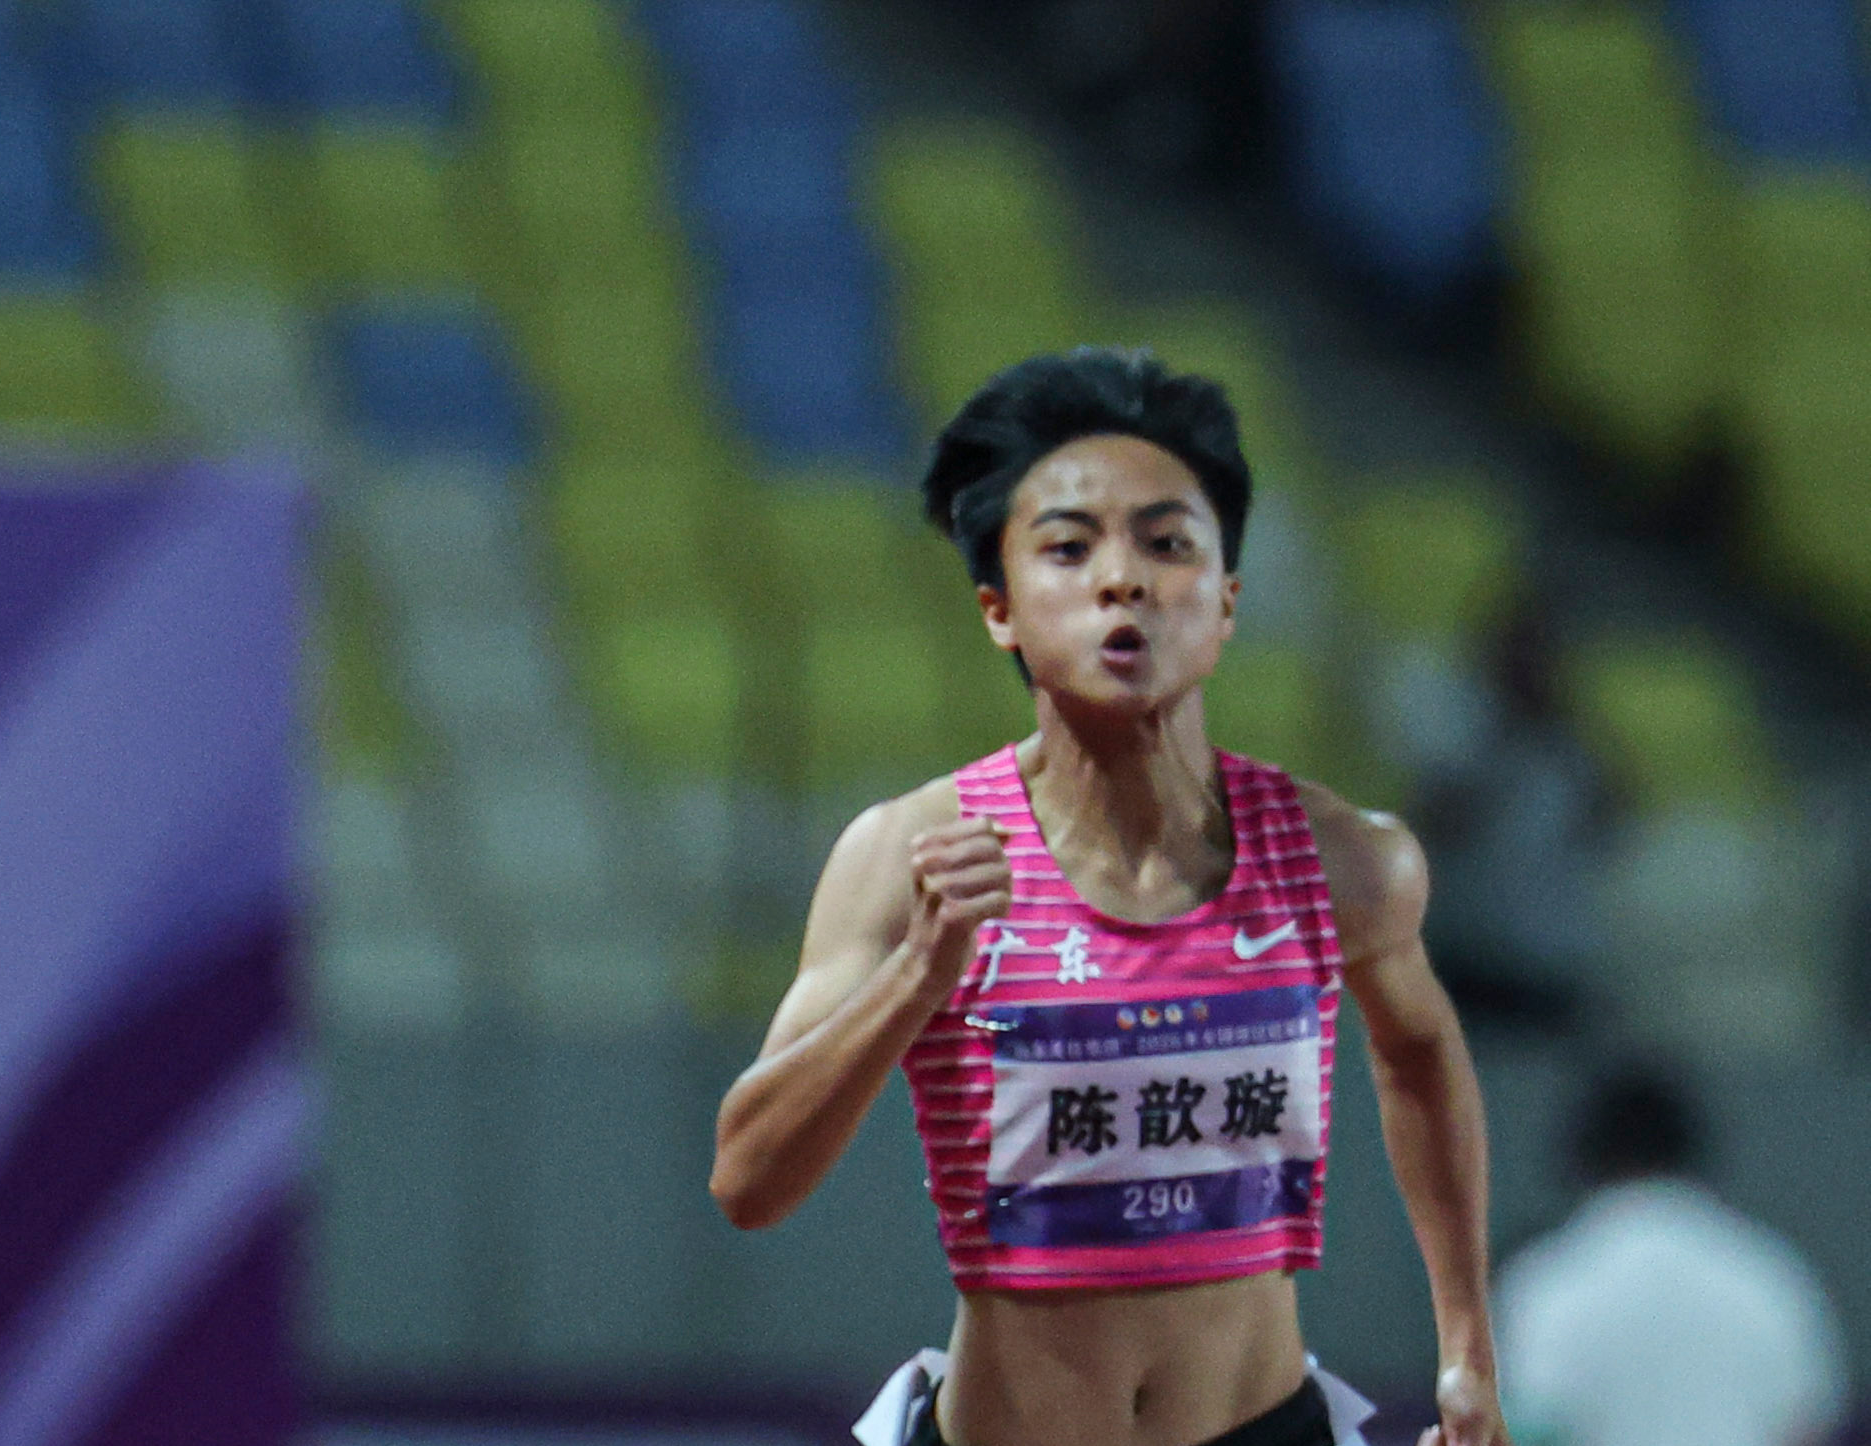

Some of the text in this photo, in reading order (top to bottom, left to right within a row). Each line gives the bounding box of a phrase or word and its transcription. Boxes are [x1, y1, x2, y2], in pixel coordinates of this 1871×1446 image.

[978, 925, 1102, 994] 广东
[1046, 1067, 1289, 1156] 陈歆璇
[1122, 1180, 1195, 1220] 290
